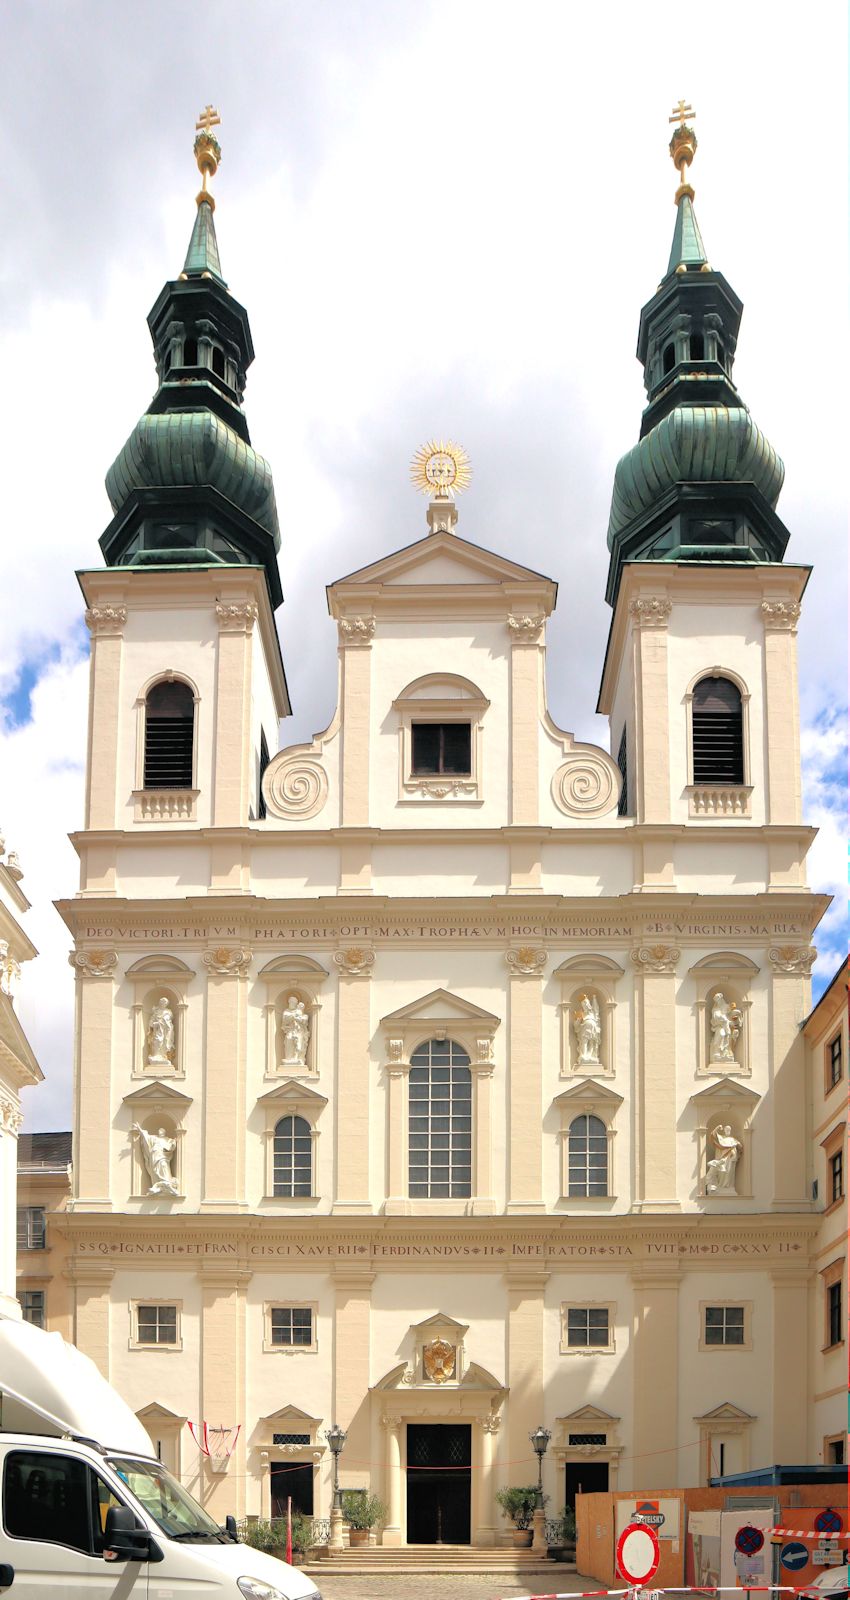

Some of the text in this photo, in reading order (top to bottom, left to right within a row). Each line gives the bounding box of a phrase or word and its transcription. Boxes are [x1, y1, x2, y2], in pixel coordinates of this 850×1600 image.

[86, 927, 114, 937] DEO
[511, 926, 541, 935] HOC
[543, 927, 558, 936] IN
[561, 927, 633, 937] MEMORIAM
[119, 1242, 175, 1253] IGNATII
[187, 1244, 203, 1254] ET
[373, 1244, 470, 1255] FERDINANDVS
